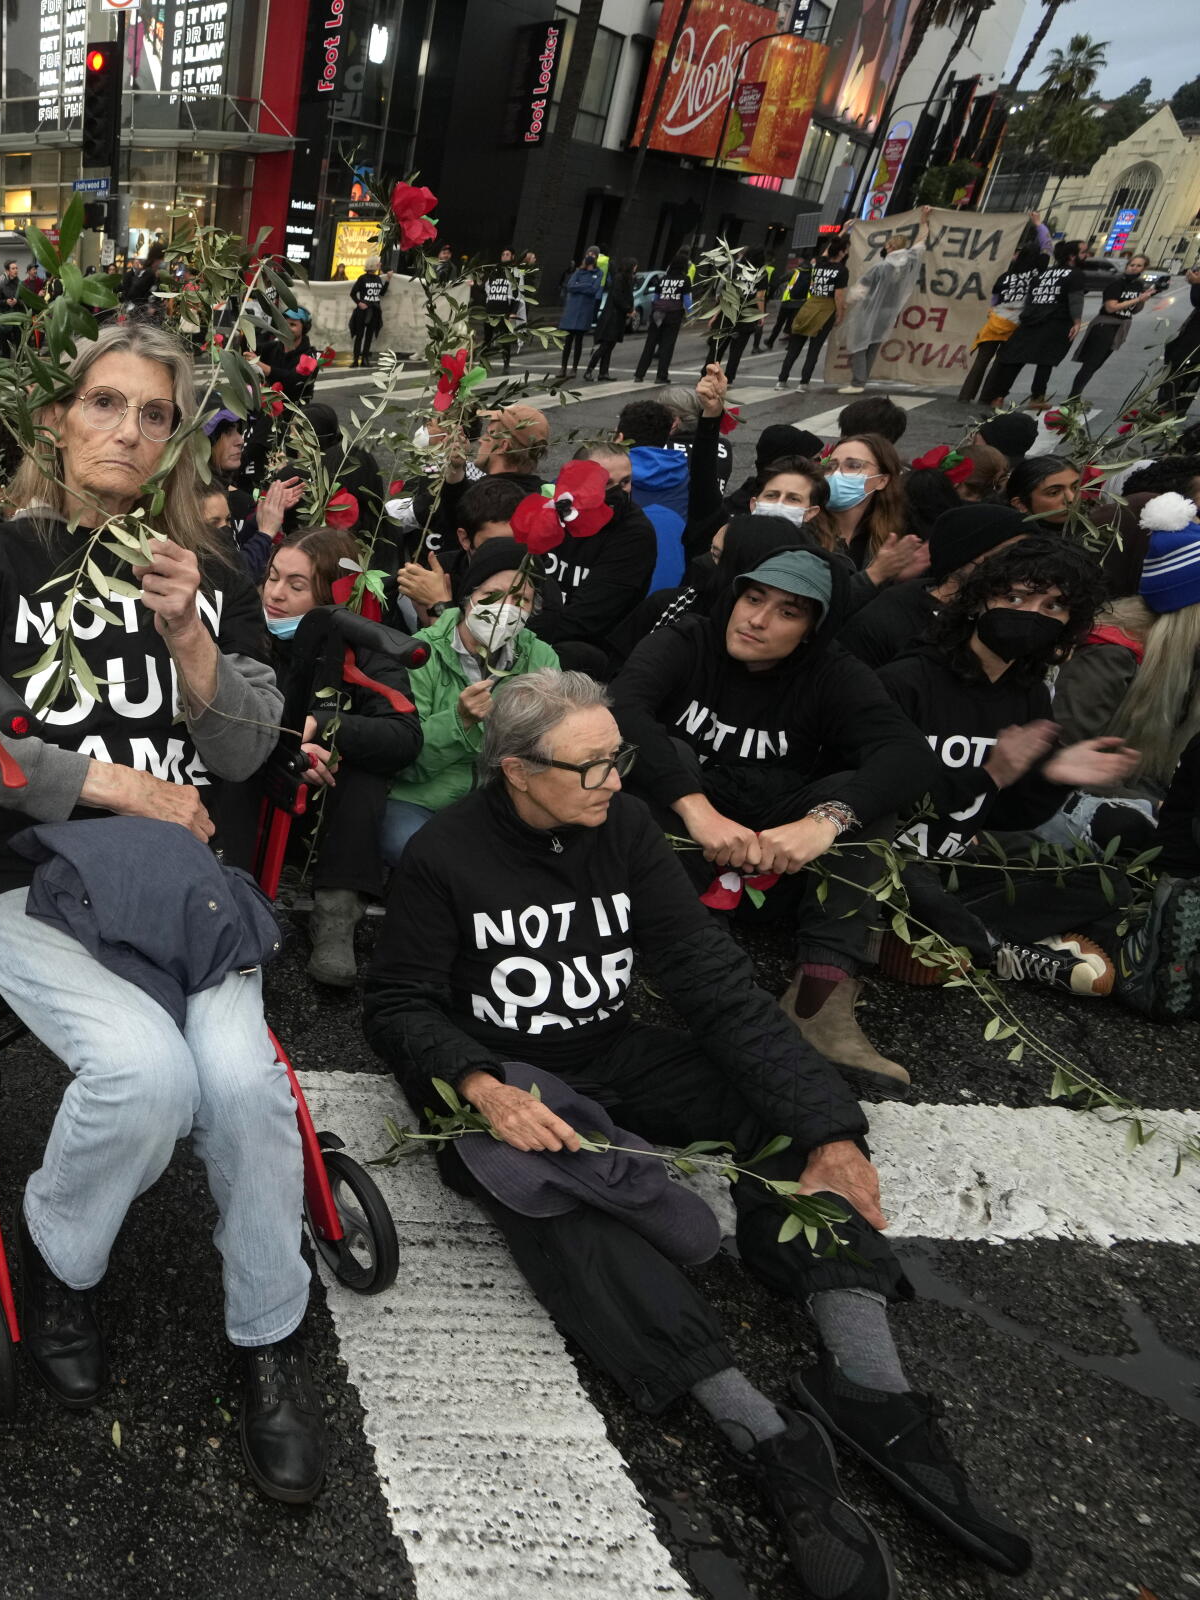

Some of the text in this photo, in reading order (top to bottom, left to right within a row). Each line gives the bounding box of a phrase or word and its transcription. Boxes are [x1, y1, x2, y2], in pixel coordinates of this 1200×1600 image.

[317, 35, 340, 92] Foot
[524, 27, 559, 142] Foot Locker
[75, 181, 100, 191] Hollywood
[1039, 268, 1073, 280] JEWS
[659, 279, 685, 288] JEWS
[1039, 278, 1059, 287] SAY
[661, 286, 677, 294] SAY
[1032, 286, 1062, 296] CEASE
[14, 590, 145, 645] NOT
[473, 901, 577, 950] NOT
[490, 947, 634, 1010] OUR
